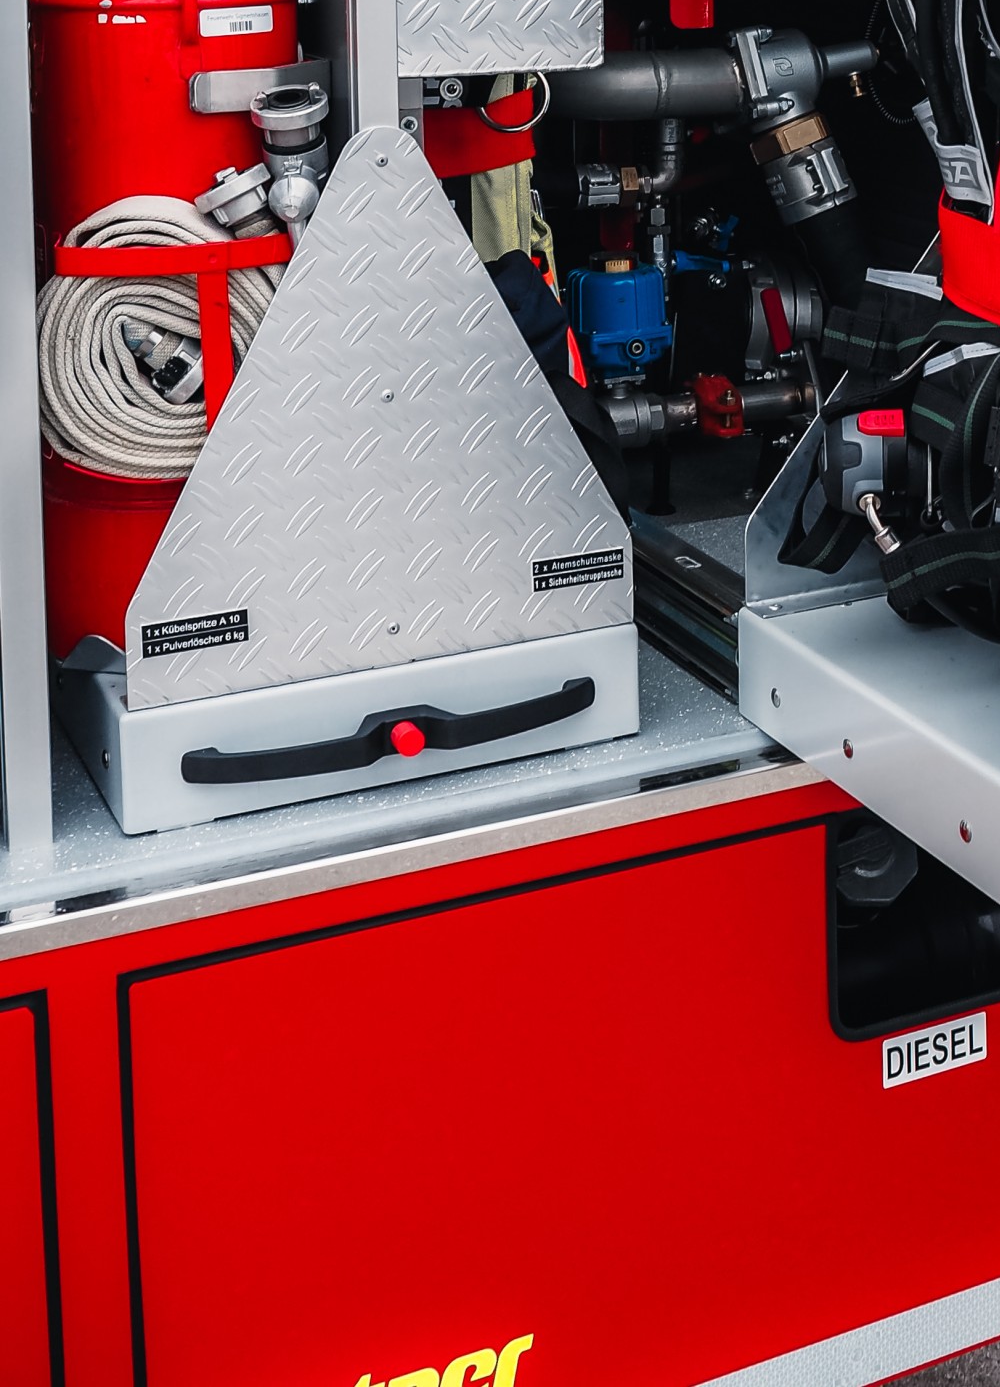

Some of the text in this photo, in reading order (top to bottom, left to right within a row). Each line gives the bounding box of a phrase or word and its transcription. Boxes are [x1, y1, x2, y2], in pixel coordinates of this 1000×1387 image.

[534, 564, 539, 573] 2
[551, 553, 622, 570] Atemschutzmaske
[548, 568, 622, 587] Sicherheitstrupptasche
[146, 614, 240, 637] 1 x Kübelspritze A 10
[147, 645, 152, 654] 1
[163, 635, 224, 652] Pulverlöscher
[225, 632, 231, 641] 6
[233, 631, 245, 640] kg
[886, 1023, 984, 1080] DIESEL
